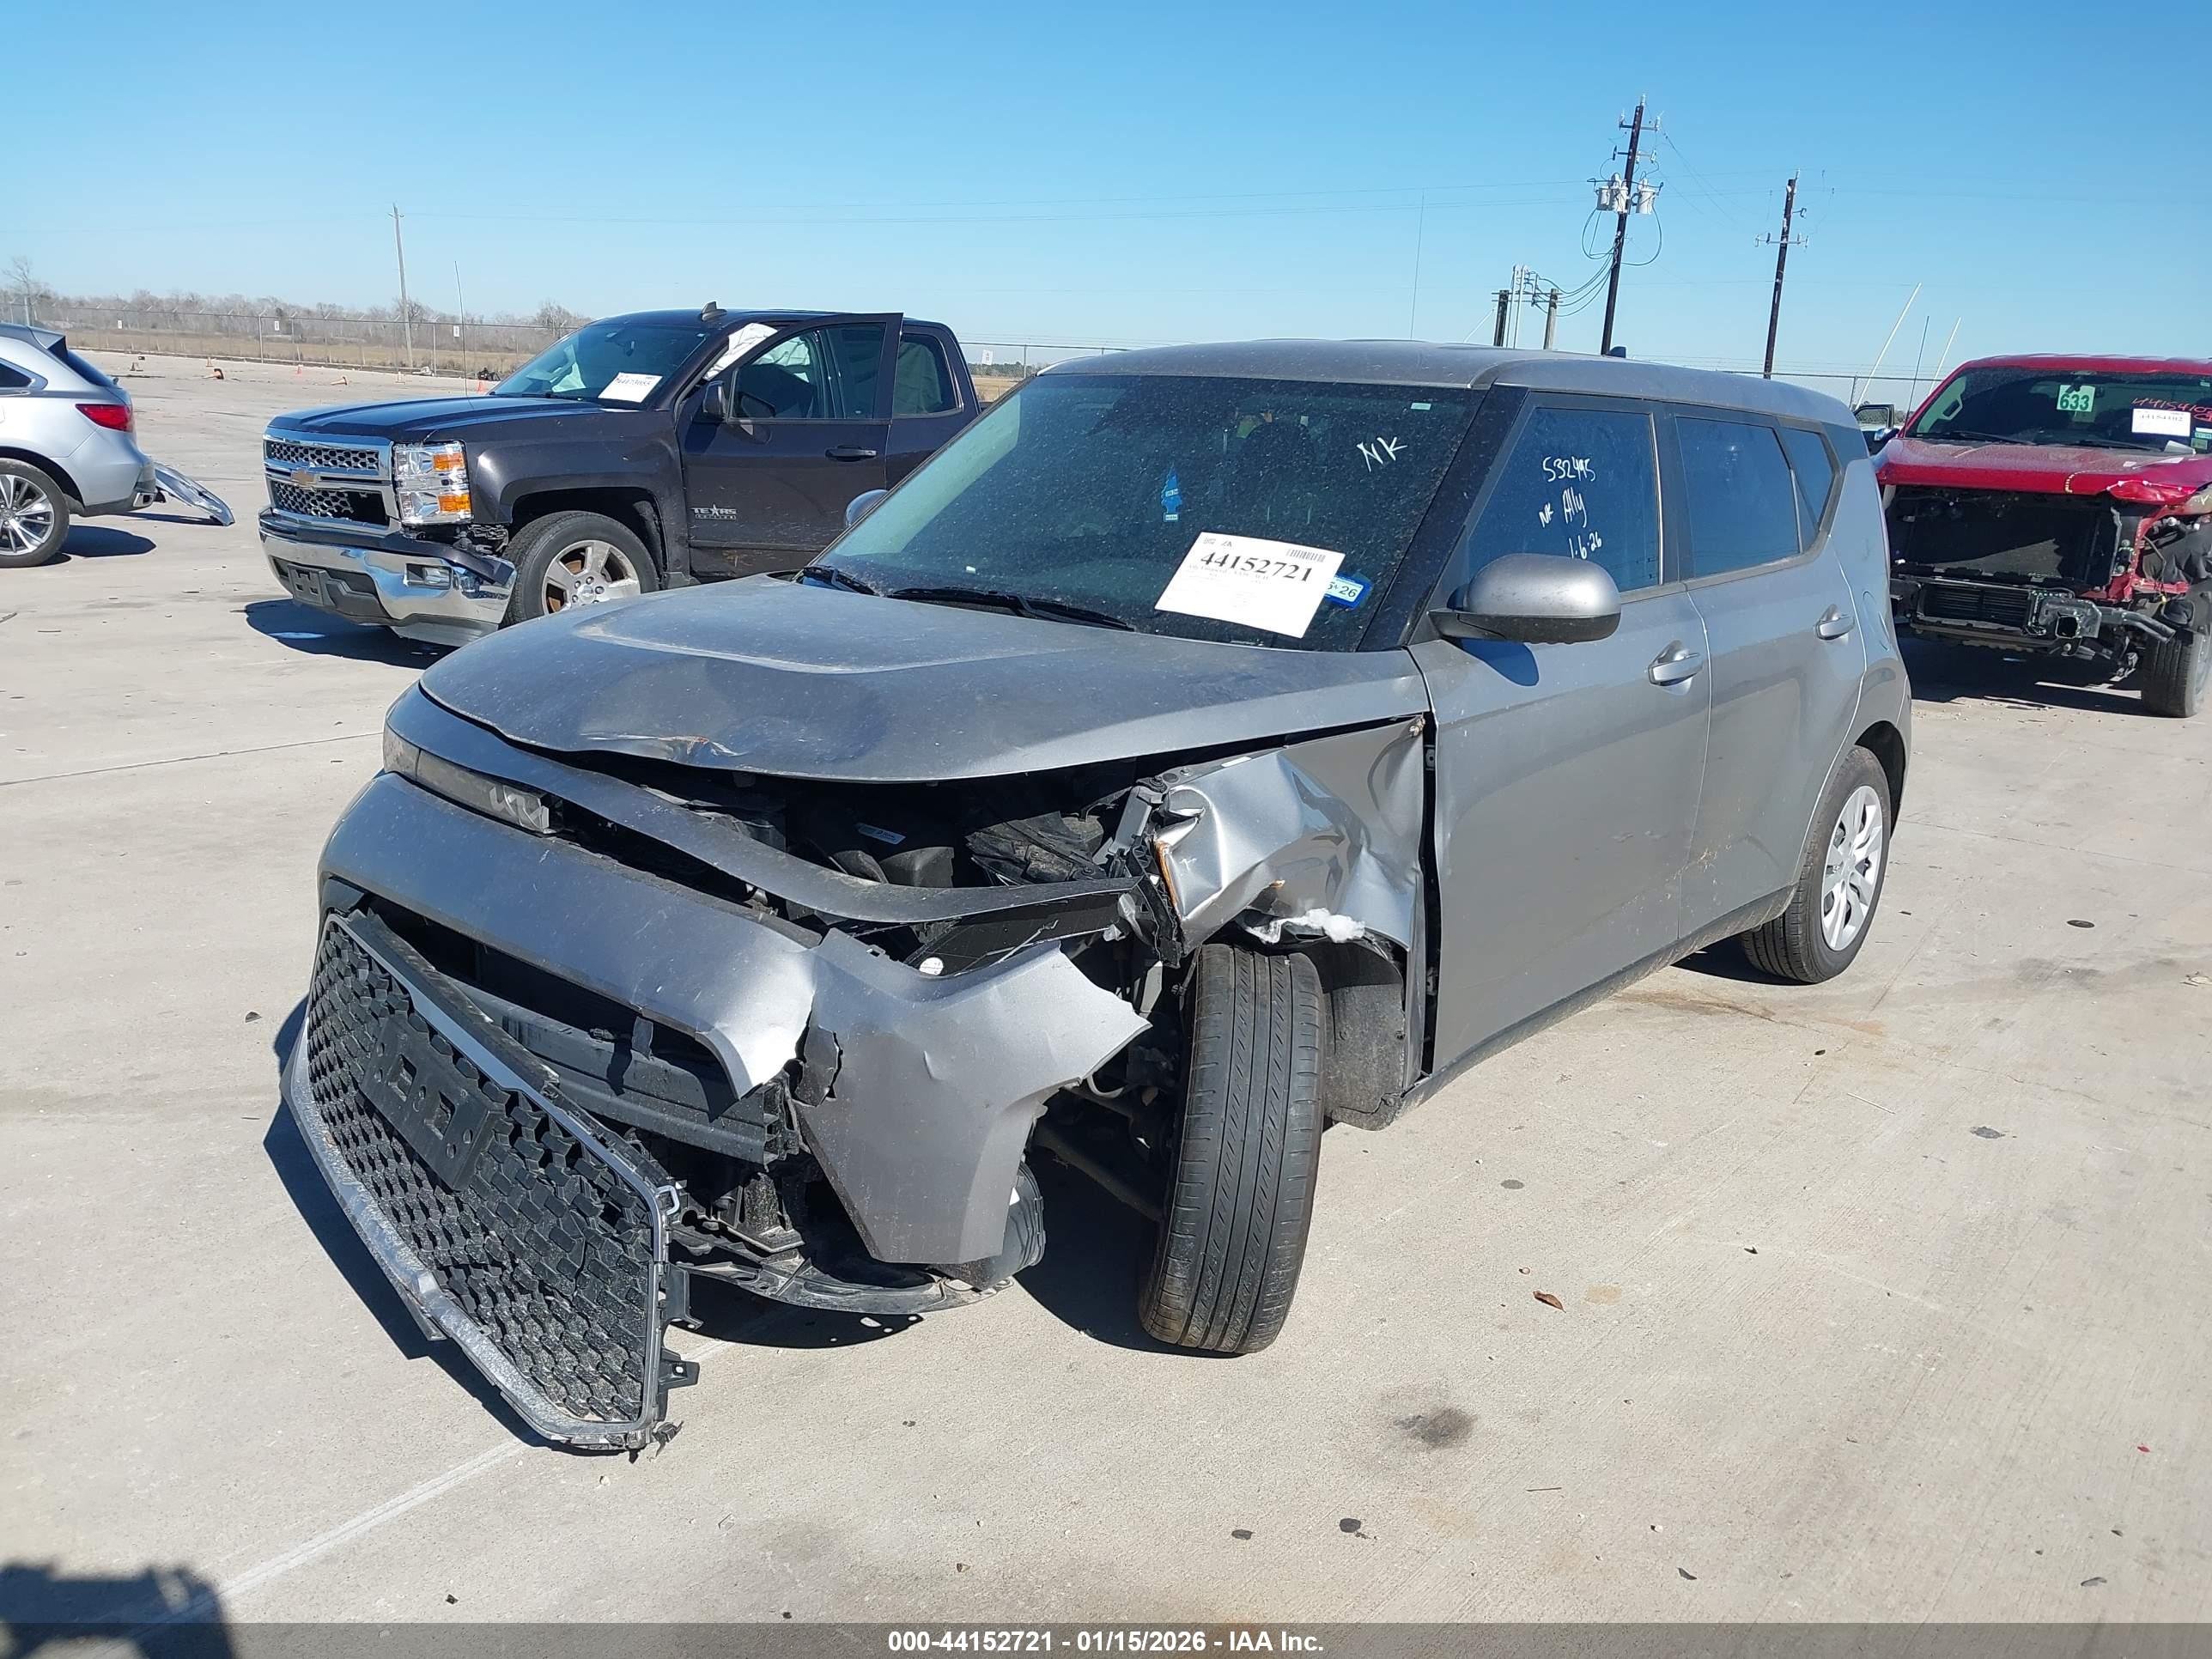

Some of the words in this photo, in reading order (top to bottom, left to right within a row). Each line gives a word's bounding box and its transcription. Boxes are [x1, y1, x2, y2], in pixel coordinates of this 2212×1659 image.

[2060, 393, 2090, 410] 633
[1200, 551, 1313, 582] 44152721
[1339, 586, 1358, 598] 26
